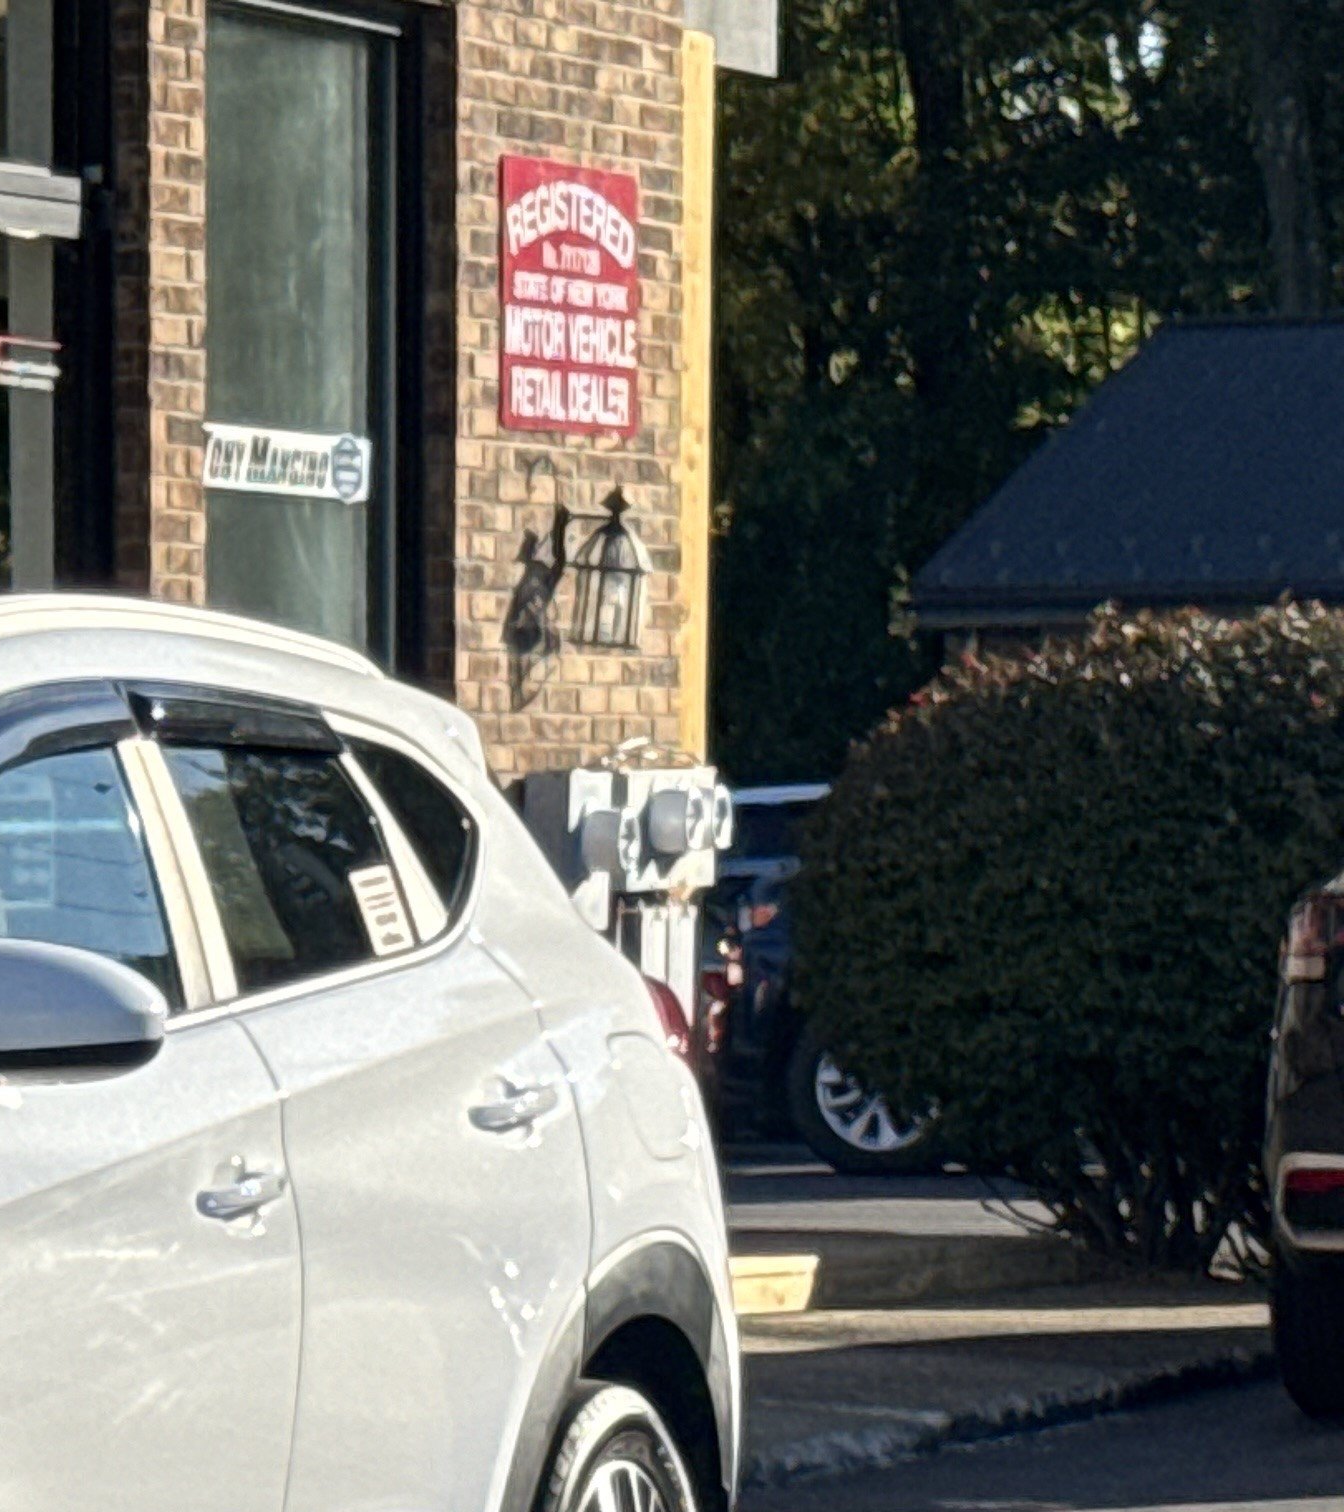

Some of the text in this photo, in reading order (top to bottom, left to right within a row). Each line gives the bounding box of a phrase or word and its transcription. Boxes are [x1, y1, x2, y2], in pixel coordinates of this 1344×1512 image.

[506, 180, 635, 269] REGISTERED
[505, 303, 638, 369] MOTOR VEHICLE
[511, 365, 630, 427] RETAIL DEALER
[203, 431, 246, 482] ONY
